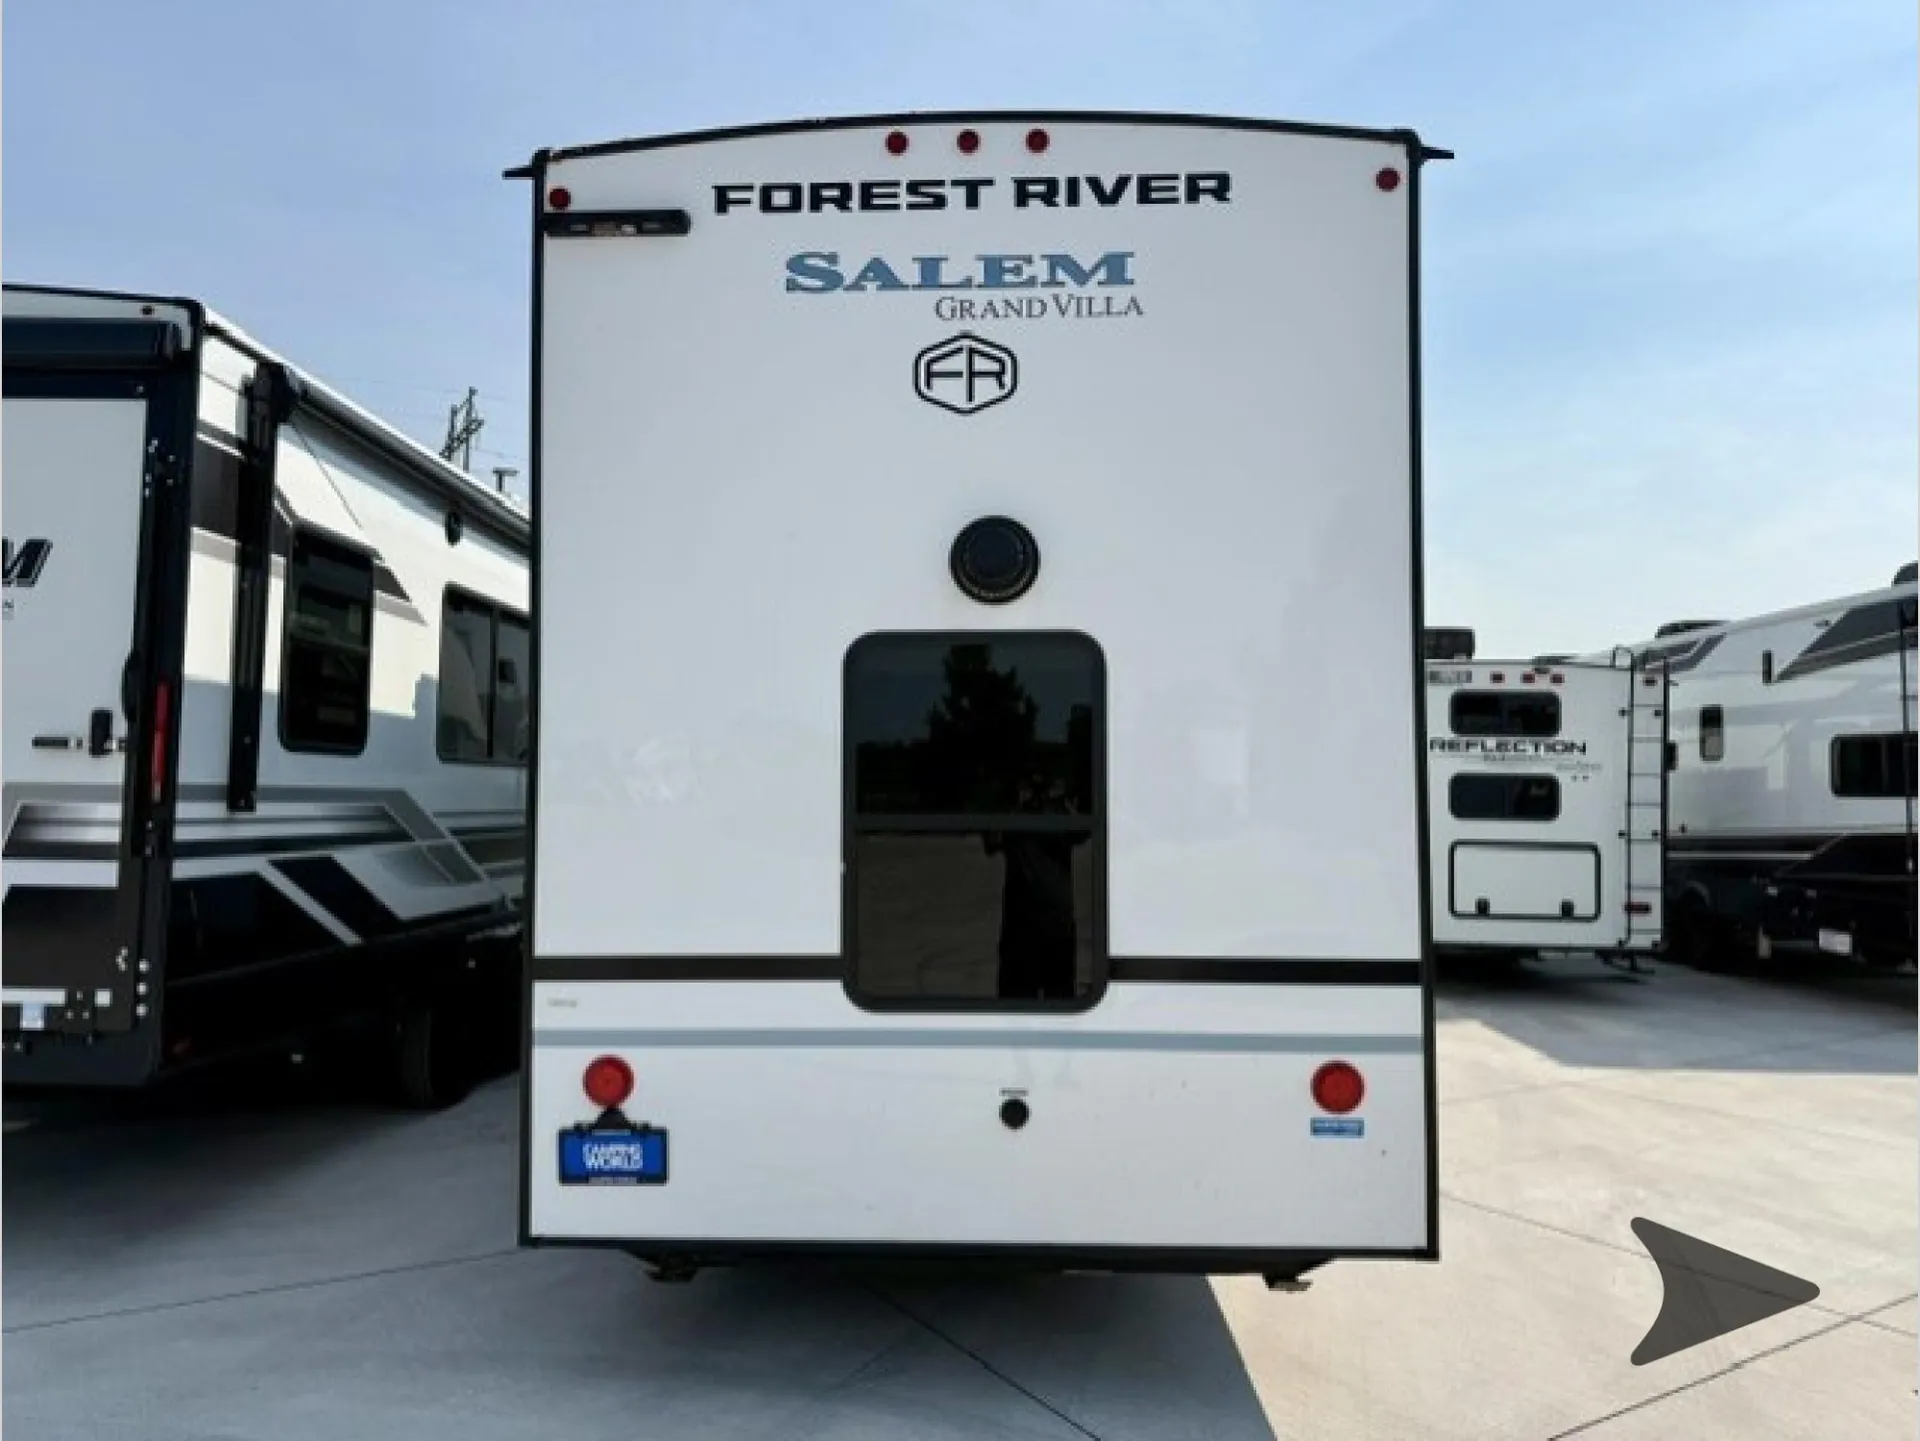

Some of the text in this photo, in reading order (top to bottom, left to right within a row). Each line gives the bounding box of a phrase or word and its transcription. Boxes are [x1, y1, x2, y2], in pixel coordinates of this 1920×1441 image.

[711, 172, 1231, 214] FOREST RIVER
[785, 251, 1135, 292] SALEM
[935, 294, 1145, 321] GRAND VILLA
[1429, 738, 1587, 755] REFLECTION
